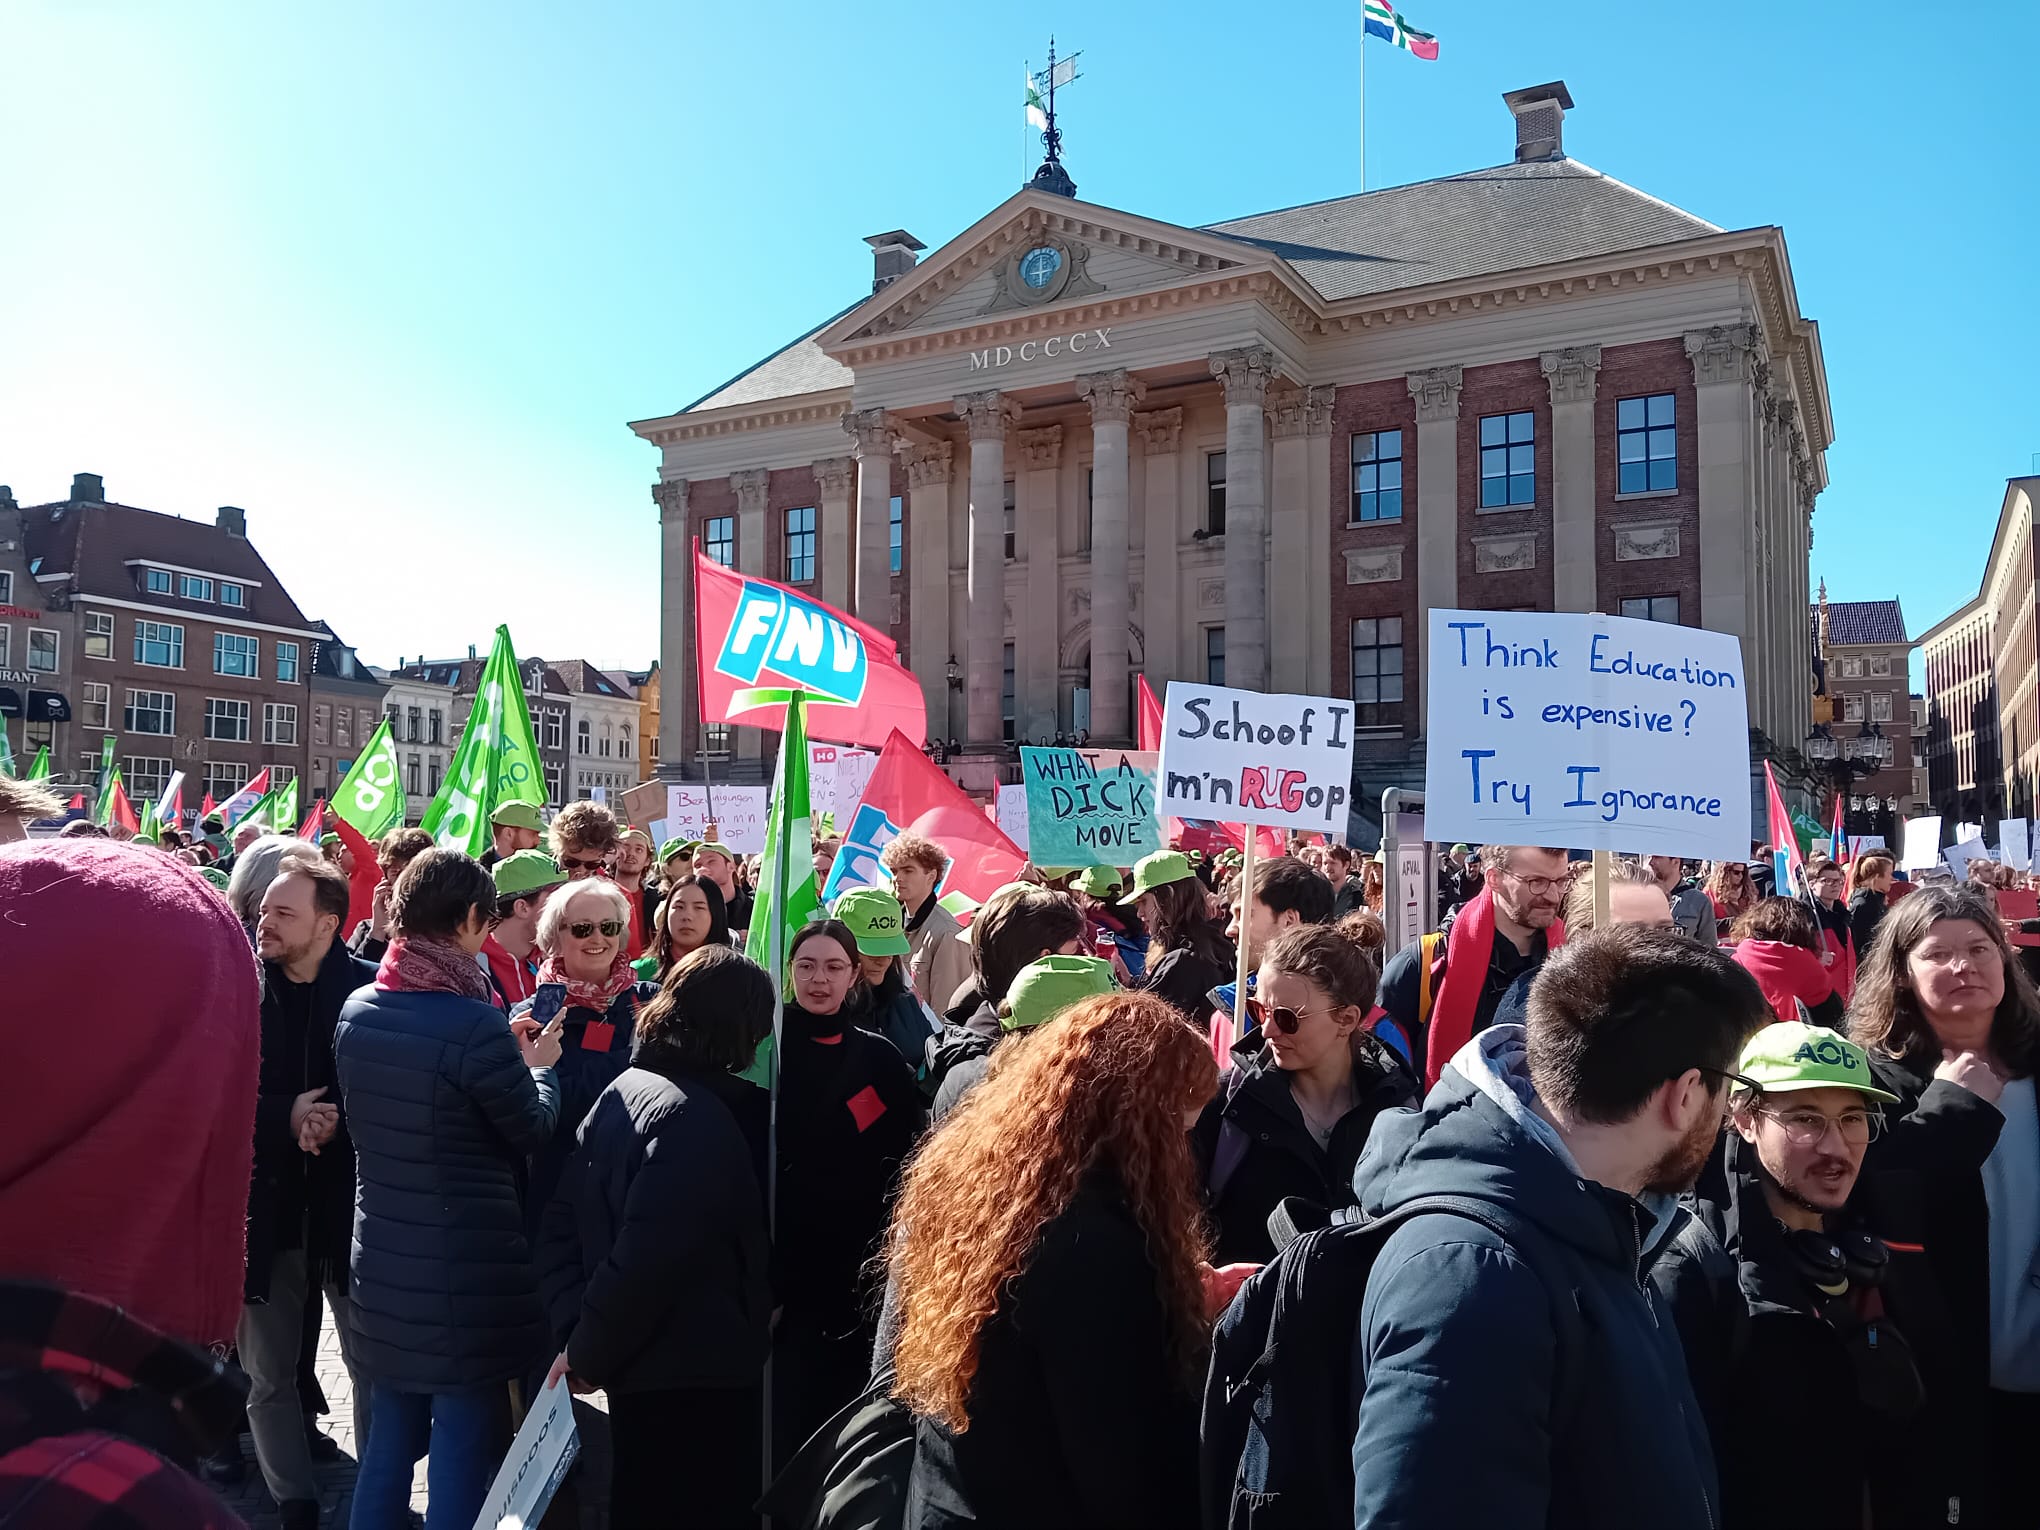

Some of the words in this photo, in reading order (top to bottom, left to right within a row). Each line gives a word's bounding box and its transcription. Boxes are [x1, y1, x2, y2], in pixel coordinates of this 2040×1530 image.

[969, 328, 1111, 371] MDCCCX
[731, 600, 859, 672] FNV
[1448, 622, 1559, 668] Think
[1590, 634, 1735, 688] Education
[1178, 697, 1314, 745] Schoof
[1326, 706, 1349, 749] I
[1482, 689, 1514, 719] is
[1541, 700, 1697, 736] expensive?
[1032, 753, 1100, 781] WHAT
[1118, 753, 1134, 778] A
[1167, 771, 1233, 804] m'n
[1462, 750, 1531, 815] Try
[1564, 766, 1721, 822] Ignorance
[1052, 780, 1148, 819] DICK
[685, 829, 704, 840] RU
[1076, 822, 1143, 849] MOVE
[1402, 860, 1421, 876] AFVAL
